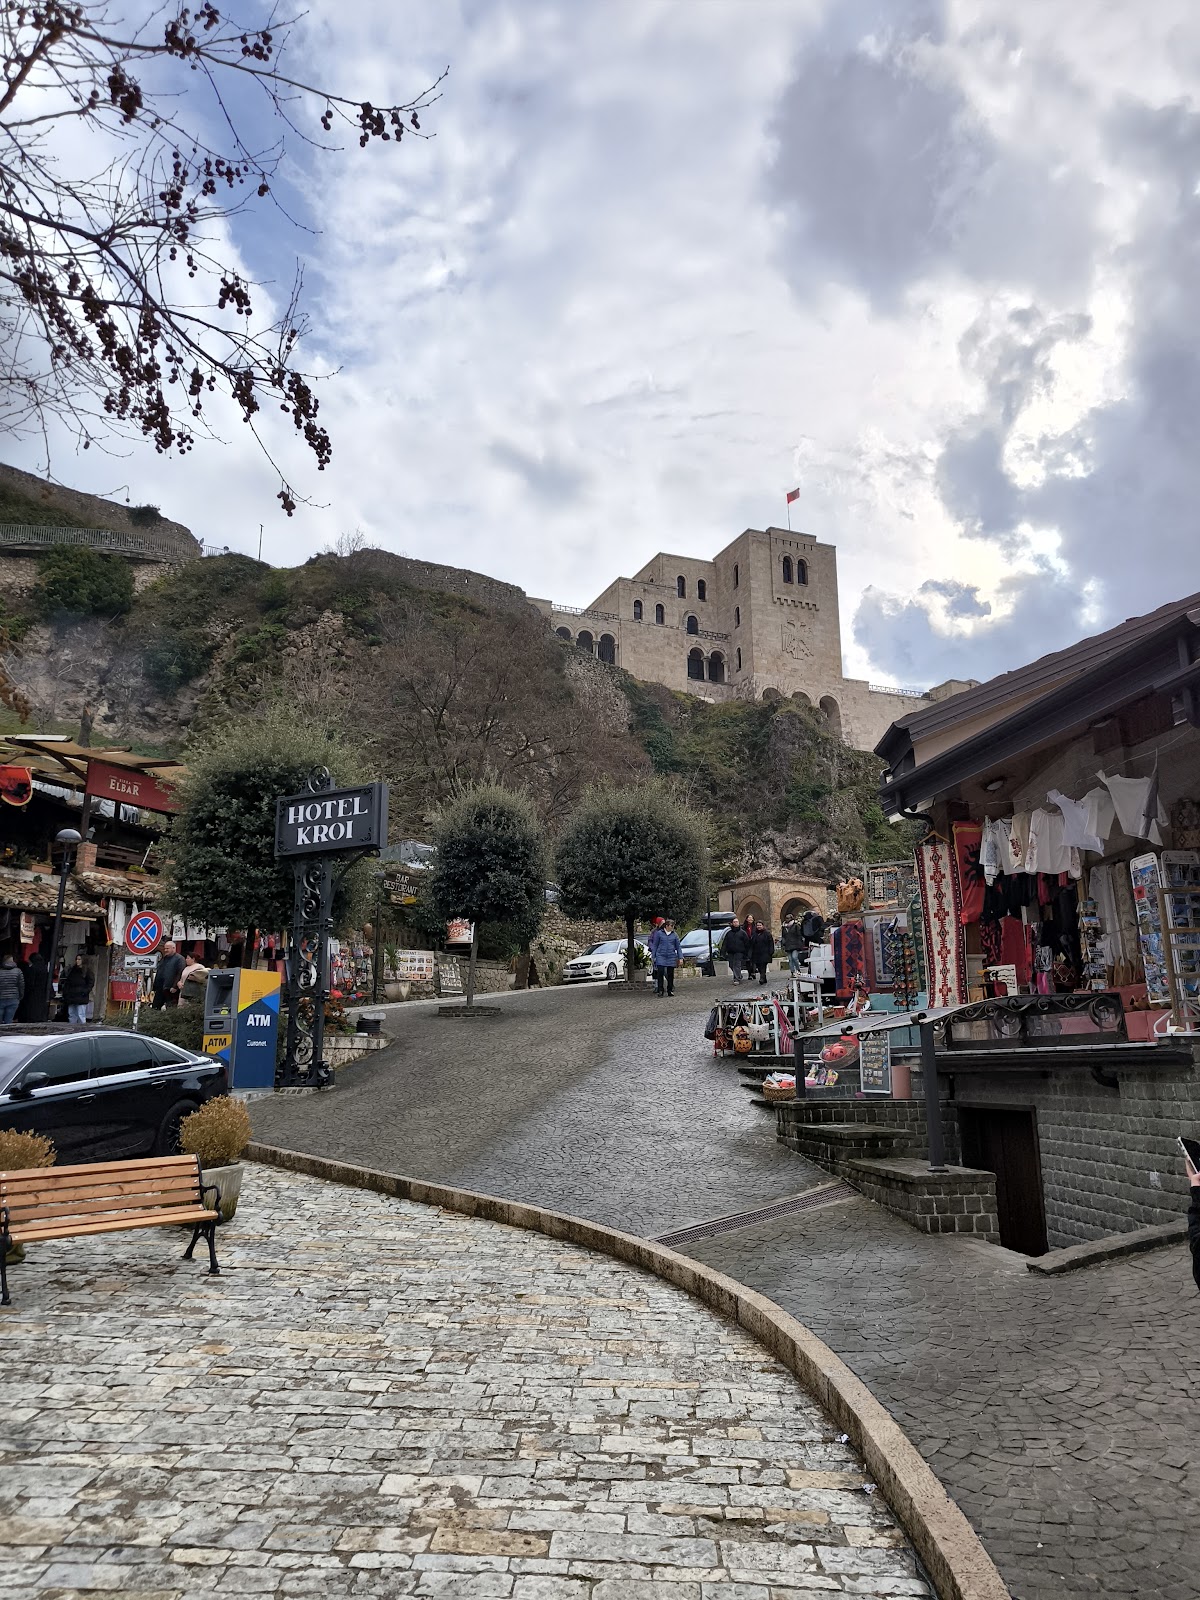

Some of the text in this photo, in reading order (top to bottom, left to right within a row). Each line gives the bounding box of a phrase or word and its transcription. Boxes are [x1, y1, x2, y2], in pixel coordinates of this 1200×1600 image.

[109, 778, 140, 796] ELBAR
[288, 796, 369, 825] HOTEL
[296, 820, 354, 846] KROI
[383, 879, 418, 895] RESTORANT
[395, 873, 410, 885] BAR
[246, 1013, 271, 1027] ATM
[208, 1037, 227, 1047] ATM
